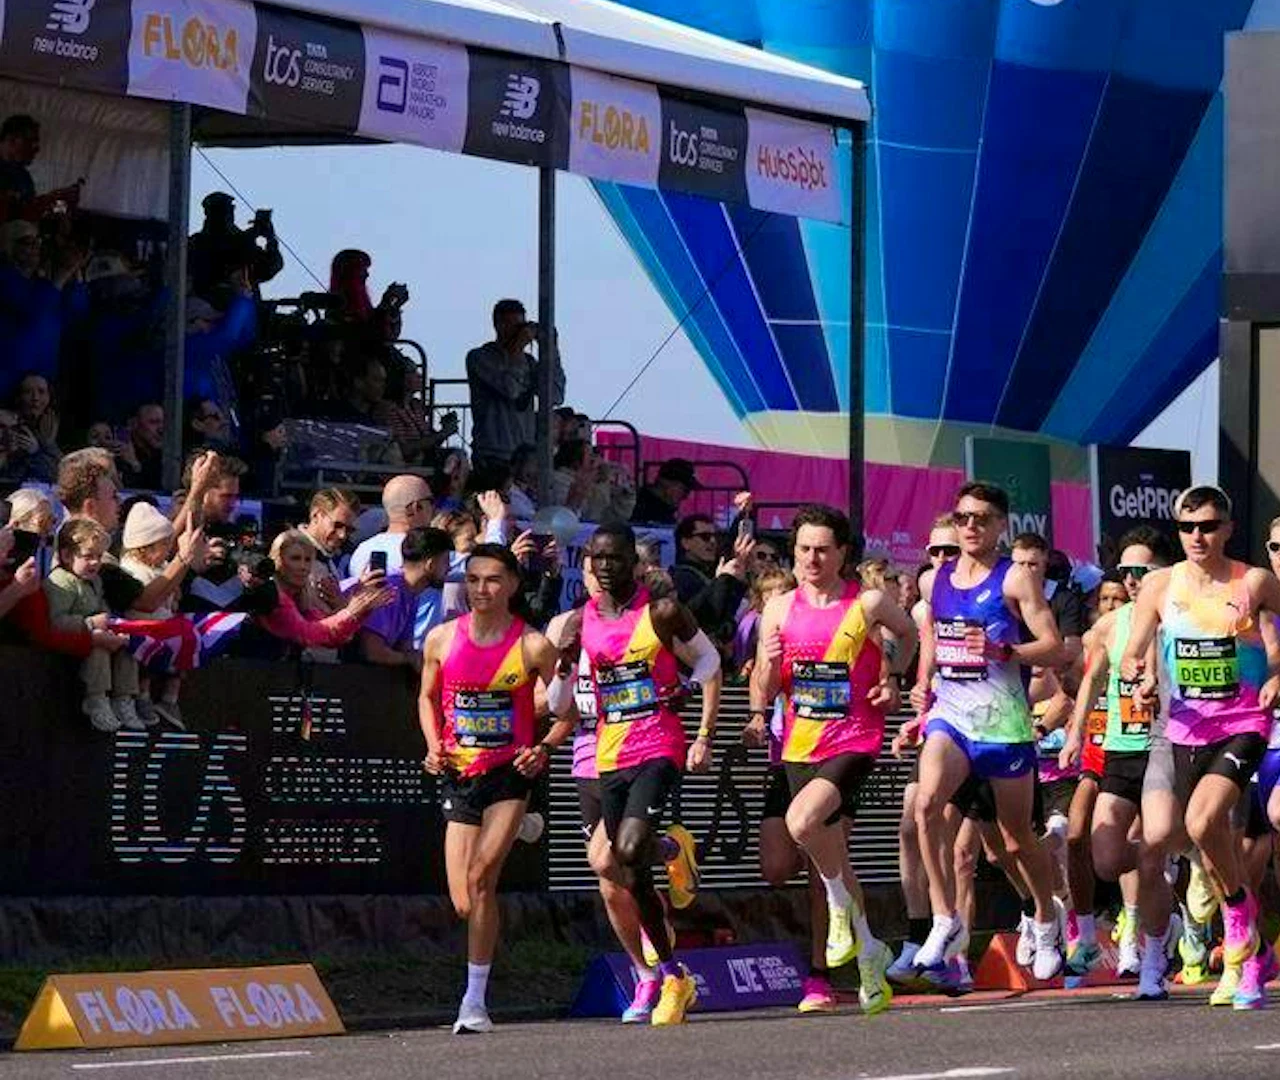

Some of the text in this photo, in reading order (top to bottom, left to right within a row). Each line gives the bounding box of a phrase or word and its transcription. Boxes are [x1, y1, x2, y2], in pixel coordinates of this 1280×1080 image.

[32, 36, 99, 62] new balance
[141, 12, 241, 72] FLORA
[264, 34, 302, 88] tcs
[510, 123, 546, 144] balance
[579, 100, 650, 154] FLORA
[669, 119, 698, 166] tcs
[757, 144, 827, 190] HubSpot
[1178, 641, 1200, 657] tcs
[1181, 666, 1233, 682] DEVER
[456, 716, 498, 732] PACE
[75, 981, 327, 1036] FLORA FLORA
